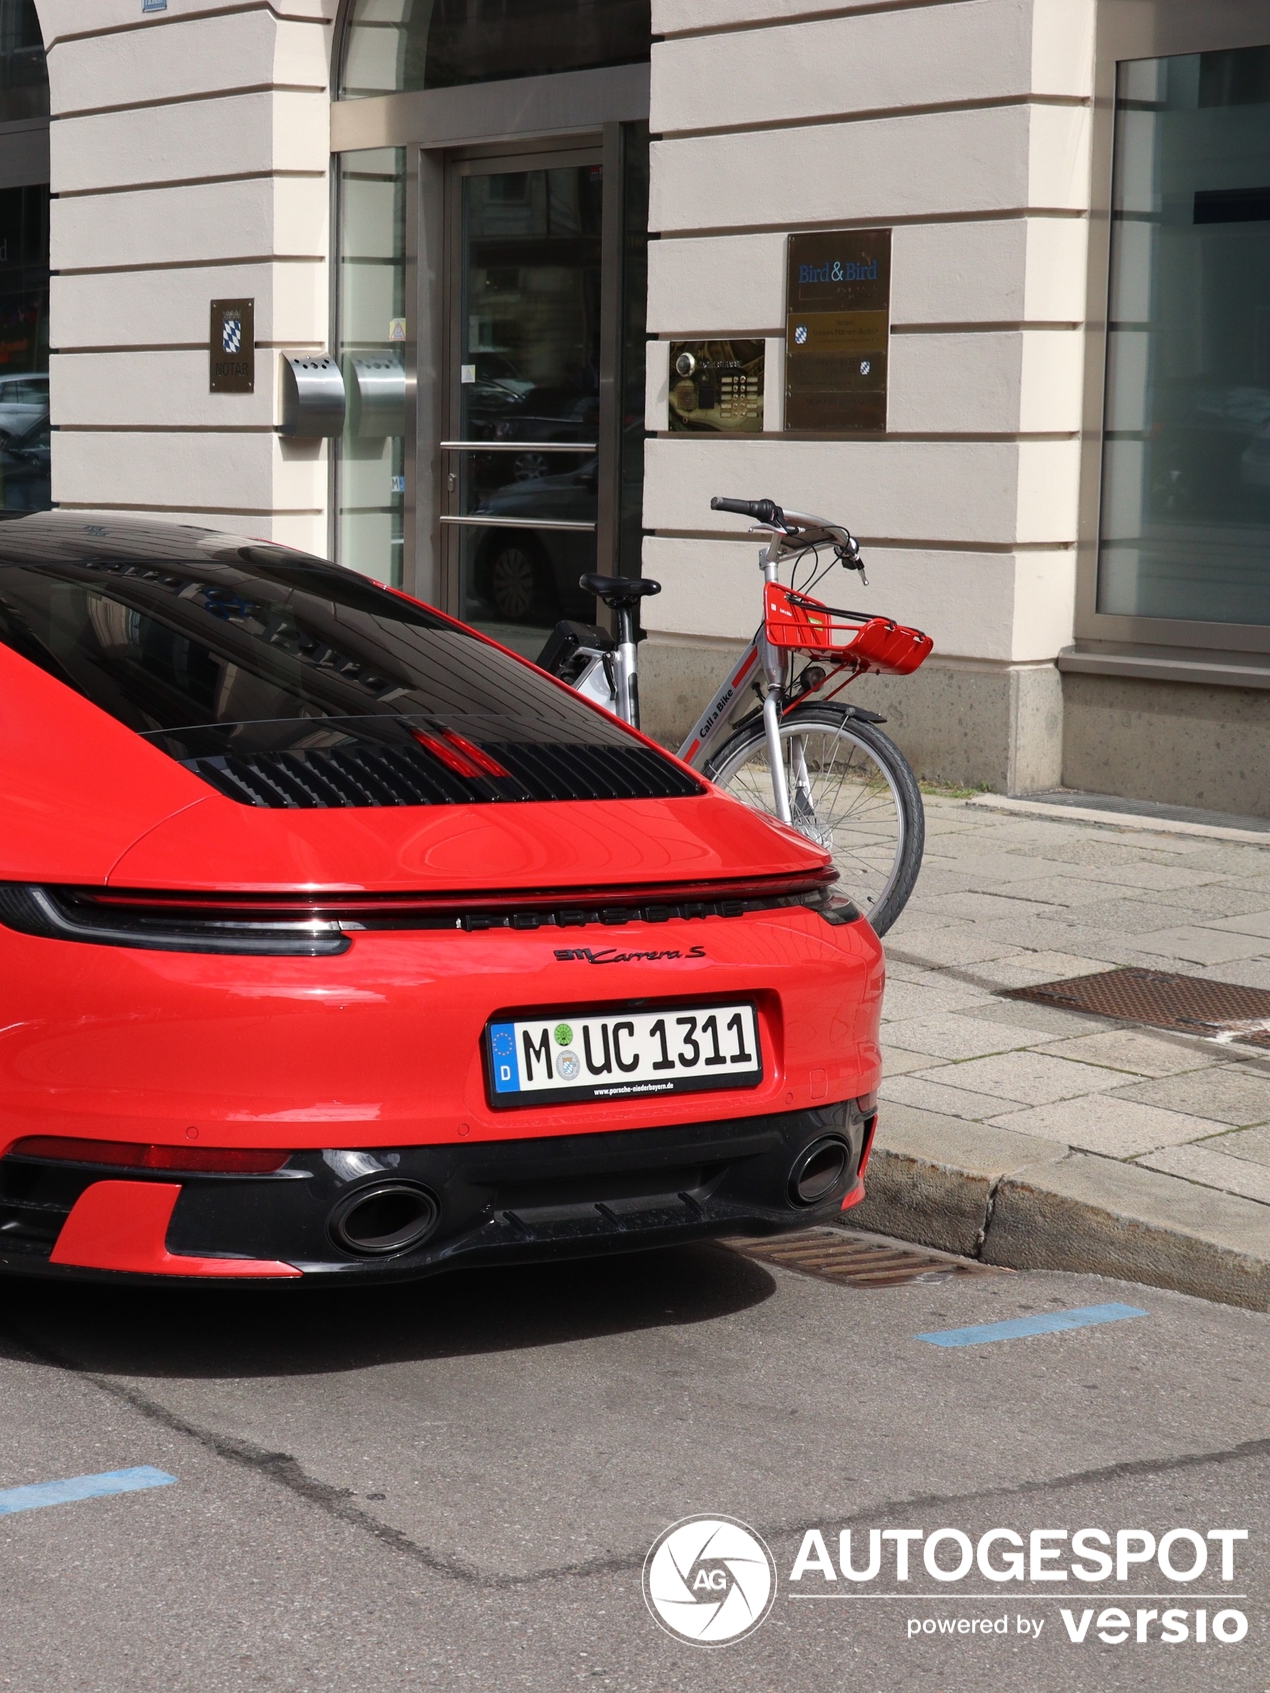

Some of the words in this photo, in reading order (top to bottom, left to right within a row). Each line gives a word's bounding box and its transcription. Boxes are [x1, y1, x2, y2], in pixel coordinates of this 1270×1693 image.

[215, 362, 249, 377] NOTAR
[699, 717, 714, 738] Call
[712, 711, 719, 720] a
[716, 689, 734, 713] Bike
[588, 949, 683, 964] Carrera
[685, 946, 706, 958] S
[522, 1028, 553, 1082] M
[582, 1021, 640, 1076] UC
[649, 1012, 752, 1071] 1311
[500, 1065, 511, 1081] D
[593, 1082, 674, 1096] www.porsche-niederbayern.de
